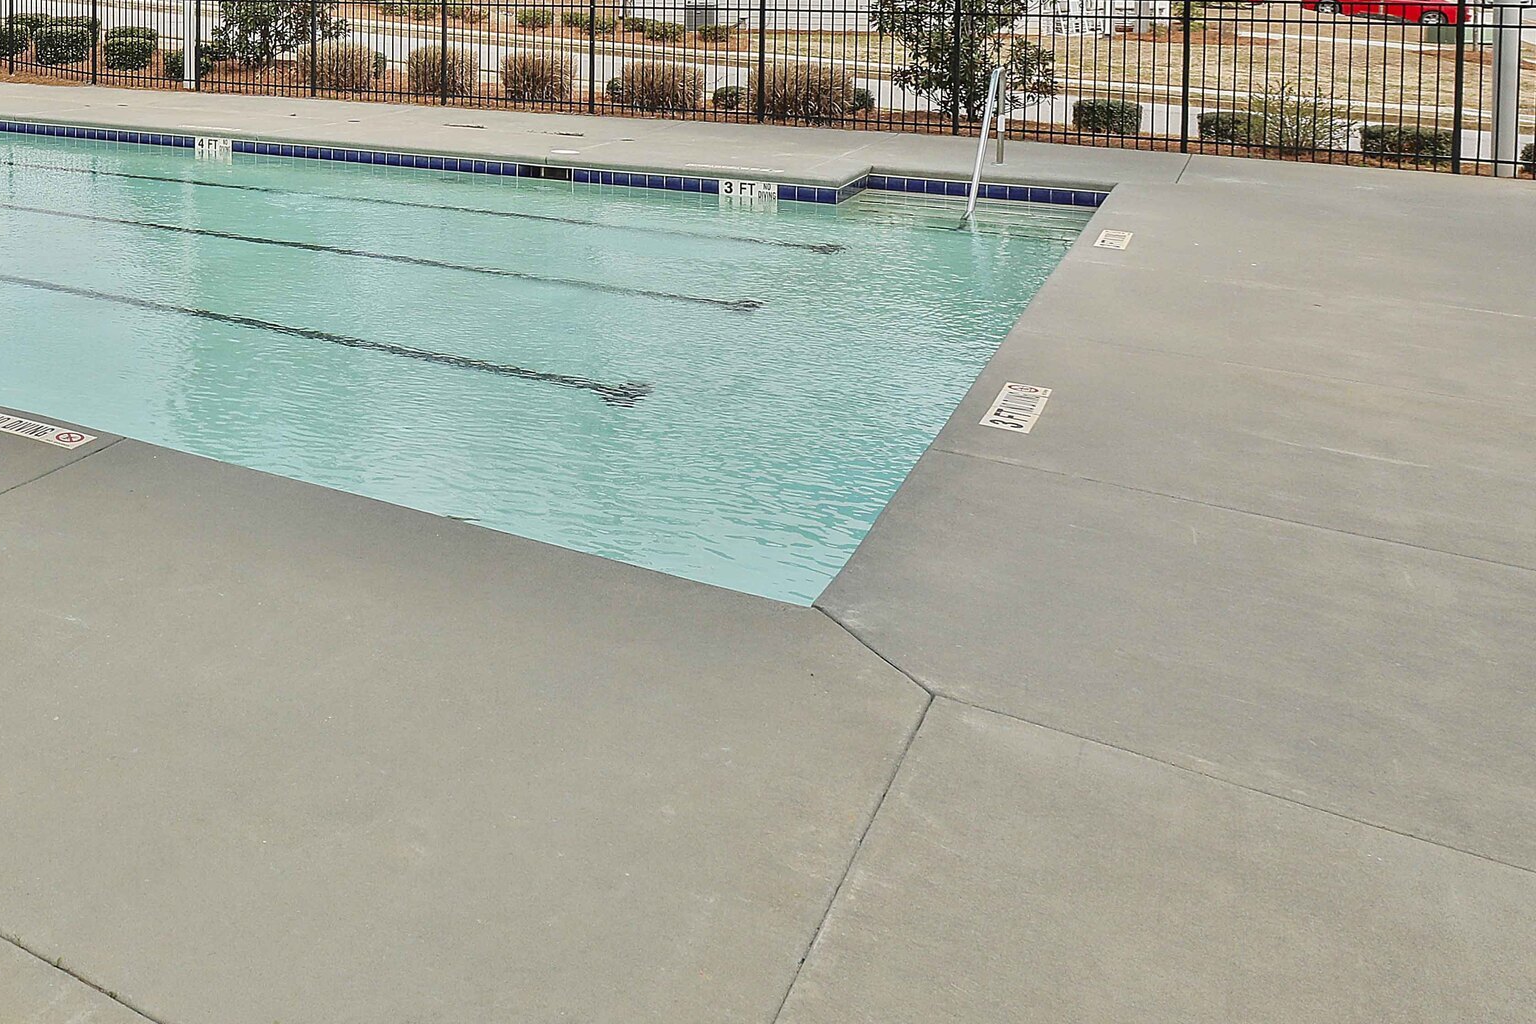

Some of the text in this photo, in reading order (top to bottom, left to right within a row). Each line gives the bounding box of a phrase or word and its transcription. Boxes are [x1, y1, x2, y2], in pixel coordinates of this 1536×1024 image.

[198, 138, 204, 149] 4
[207, 139, 218, 150] FT
[724, 181, 756, 196] 3 FT
[763, 183, 772, 191] NO
[1, 420, 55, 437] DIVING
